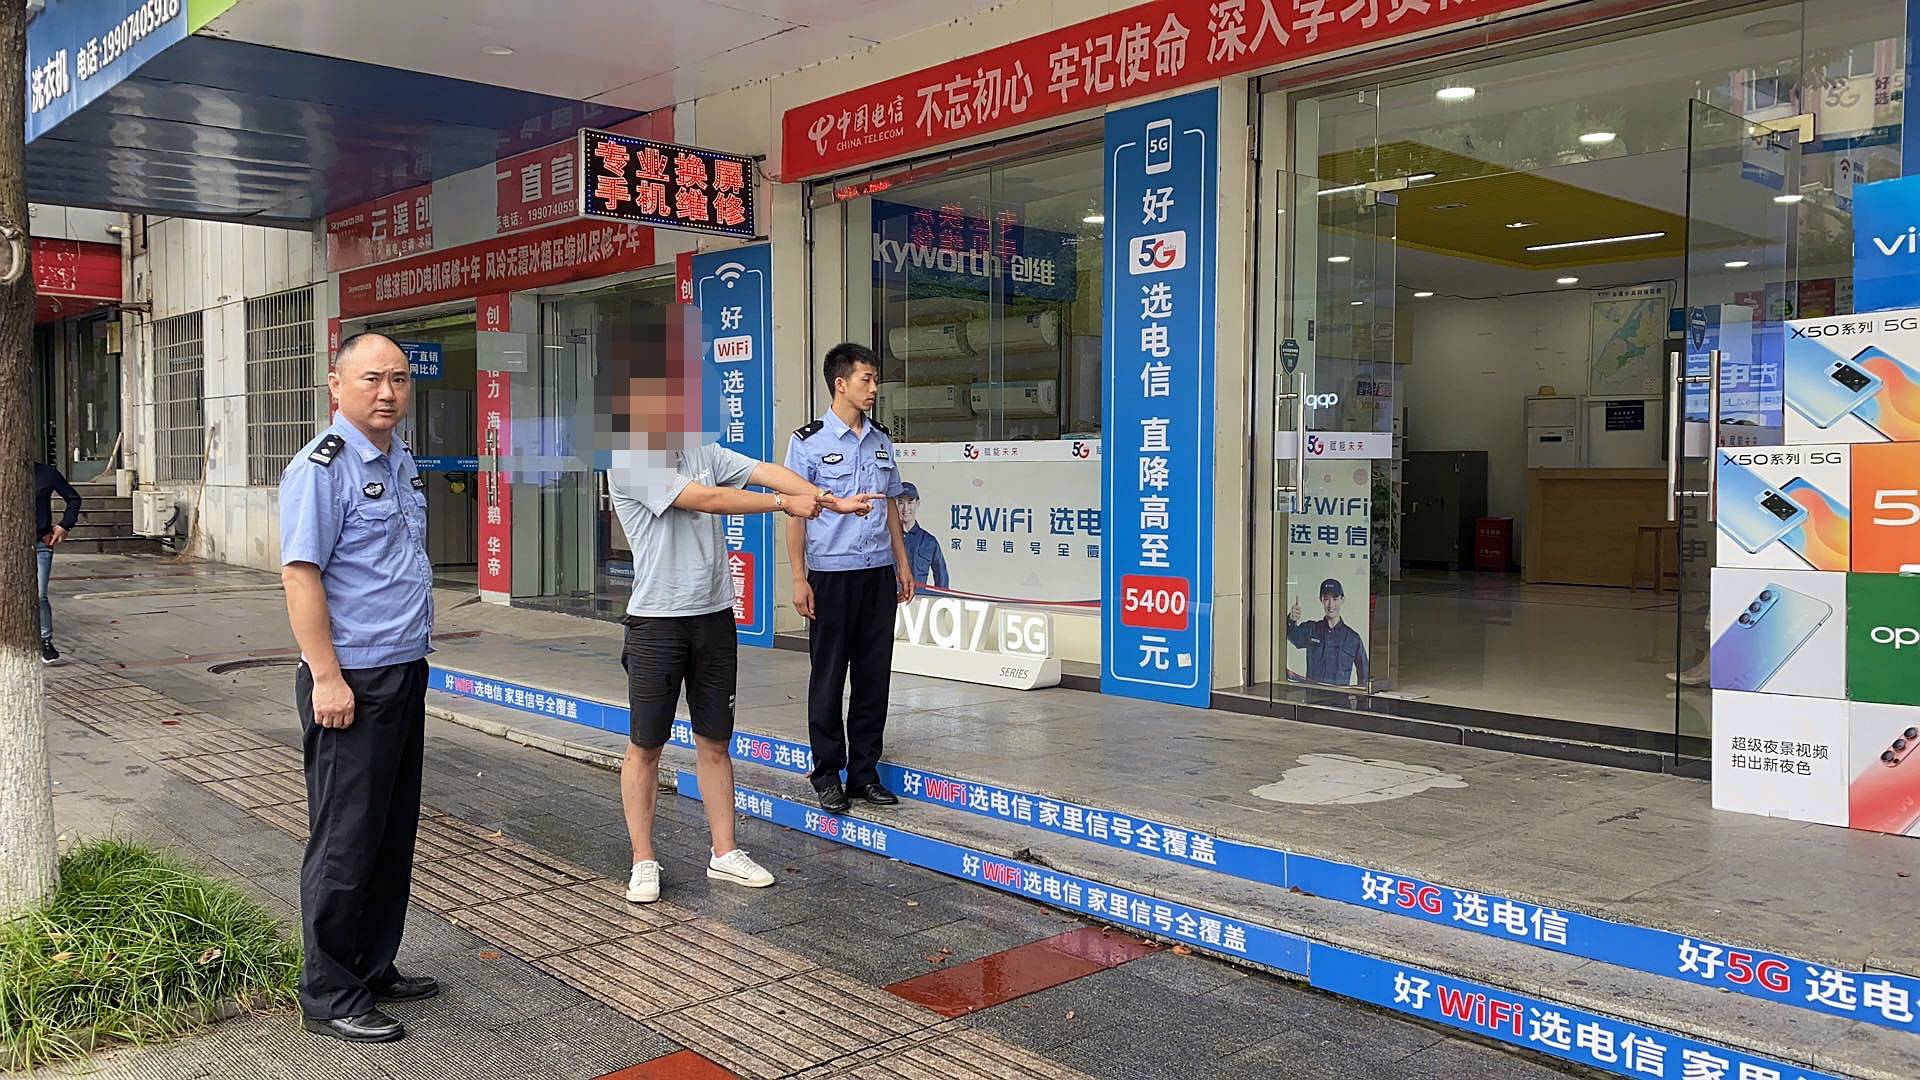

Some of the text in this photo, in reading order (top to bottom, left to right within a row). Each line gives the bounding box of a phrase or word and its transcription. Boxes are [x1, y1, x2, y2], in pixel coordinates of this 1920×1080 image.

[31, 48, 70, 113] 洗衣机
[836, 0, 1476, 138] 中国电信 不忘初心 牢记使命 深入学习
[836, 127, 905, 152] CHINA TELECOM
[1150, 137, 1168, 153] 5G
[595, 140, 744, 194] 专业换屏
[595, 175, 747, 226] 手机维修
[1873, 226, 1920, 256] vi
[1011, 254, 1055, 286] 创维
[721, 306, 743, 330] 好
[1791, 317, 1918, 340] X50系列 5G
[404, 350, 438, 362] 厂直销
[718, 340, 749, 357] WiFi
[410, 363, 438, 376] 网比价
[723, 370, 744, 443] 选电信
[1124, 187, 1186, 670] 好 5G 选电信 直降高至 5400 元
[963, 443, 980, 460] 5G
[1071, 441, 1090, 459] 5G
[1307, 434, 1325, 456] 5G
[1723, 452, 1842, 467] X50系列 5G
[951, 504, 1101, 536] 好WiFi 选电
[1291, 496, 1368, 517] 好WiFi
[1291, 524, 1368, 546] 选电信
[487, 536, 501, 576] 华帝
[893, 597, 1046, 653] va7 5G
[1000, 666, 1029, 680] SERIES
[504, 687, 578, 720] 家里信号全覆盖
[736, 736, 772, 761] 好5G
[1731, 736, 1829, 760] 超级夜景视频
[1731, 753, 1812, 776] 拍出新夜色
[804, 813, 888, 851] 好5G 选电信
[1038, 800, 1217, 866] 家里信号全覆盖
[1087, 886, 1247, 953] 家里信号全覆盖
[1361, 871, 1569, 946] 好5G 选电信
[1677, 938, 1920, 1024] 好5G 选电
